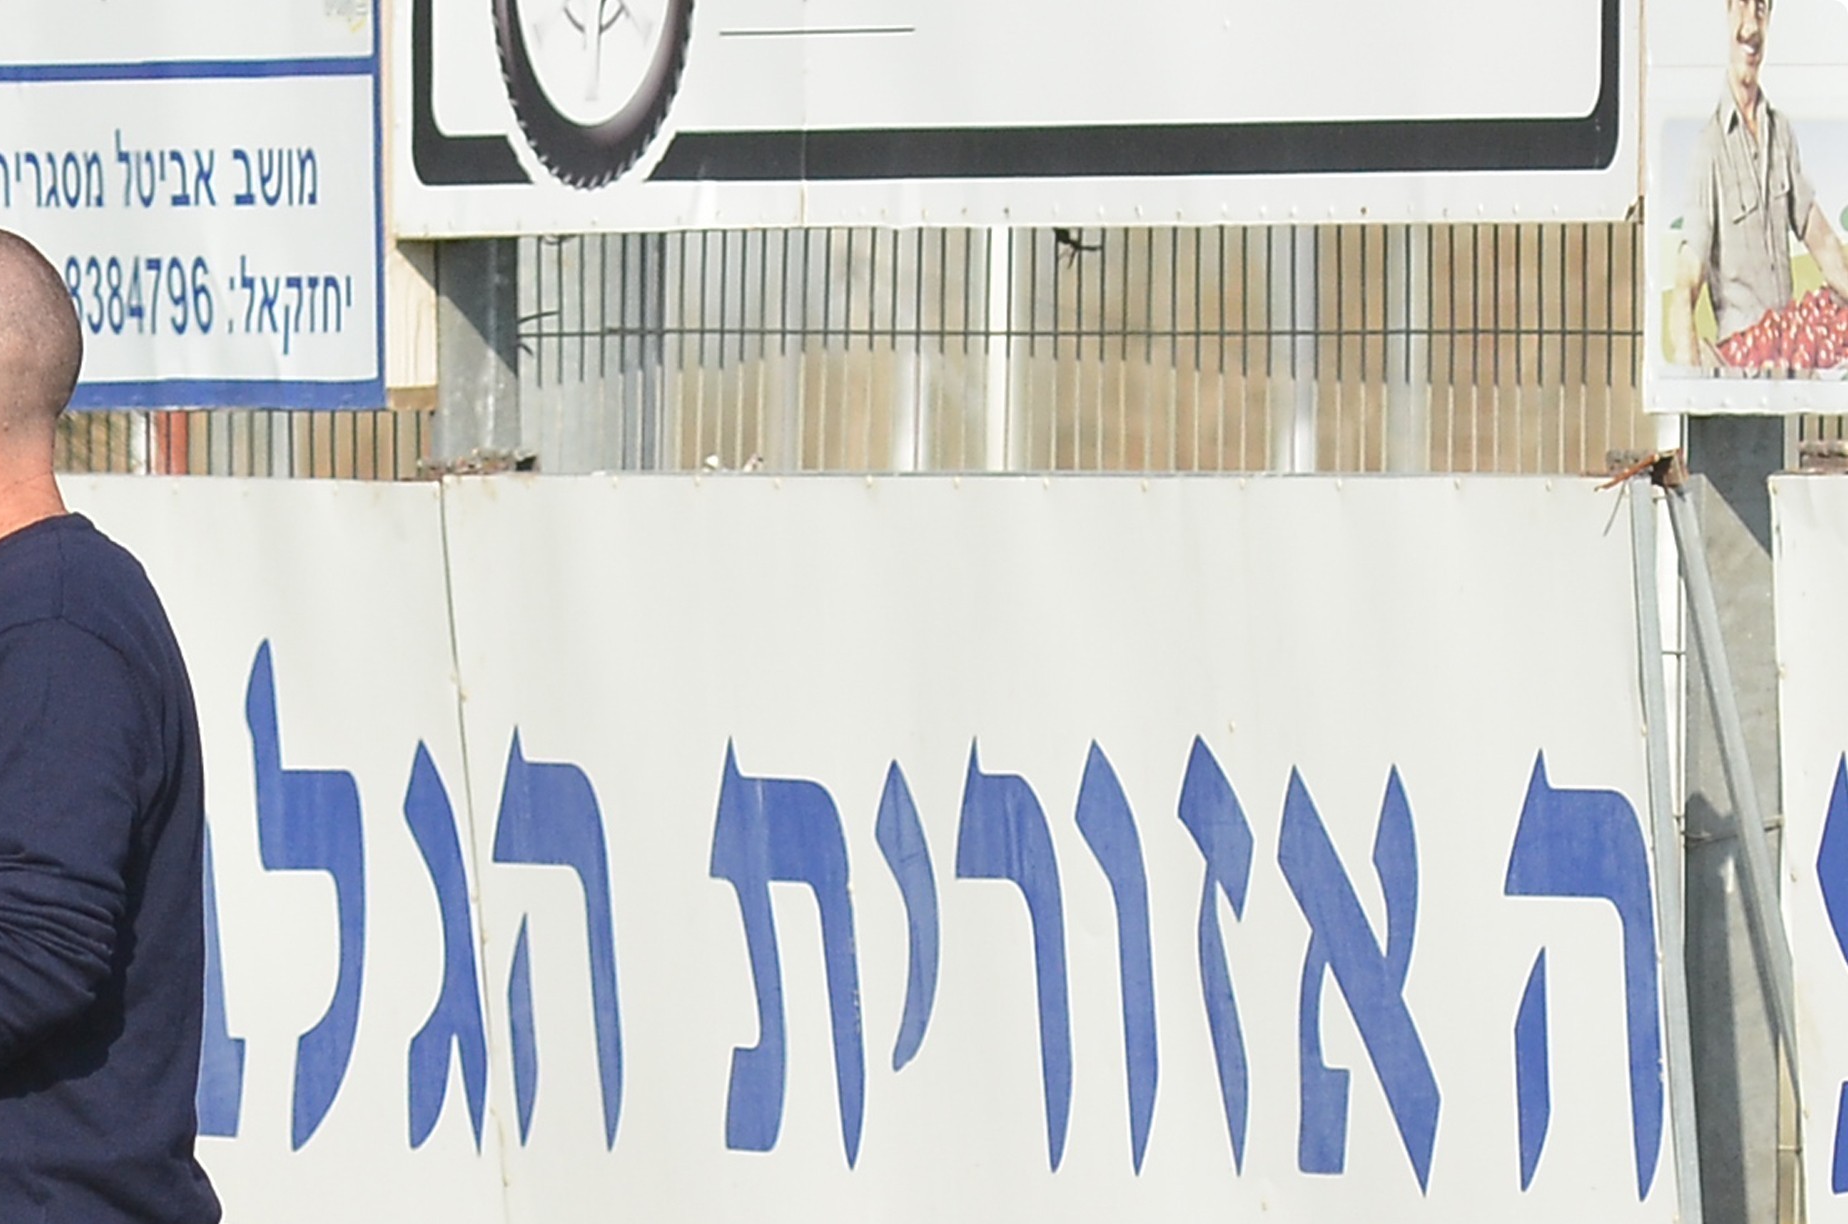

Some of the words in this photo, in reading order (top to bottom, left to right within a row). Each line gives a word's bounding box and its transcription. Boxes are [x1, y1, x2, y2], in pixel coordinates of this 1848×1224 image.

[115, 132, 218, 209] אביטל
[232, 147, 320, 208] מושב
[64, 256, 215, 337] 8384796
[228, 255, 353, 356] יחזקאל:
[709, 735, 1443, 1196] אזורית
